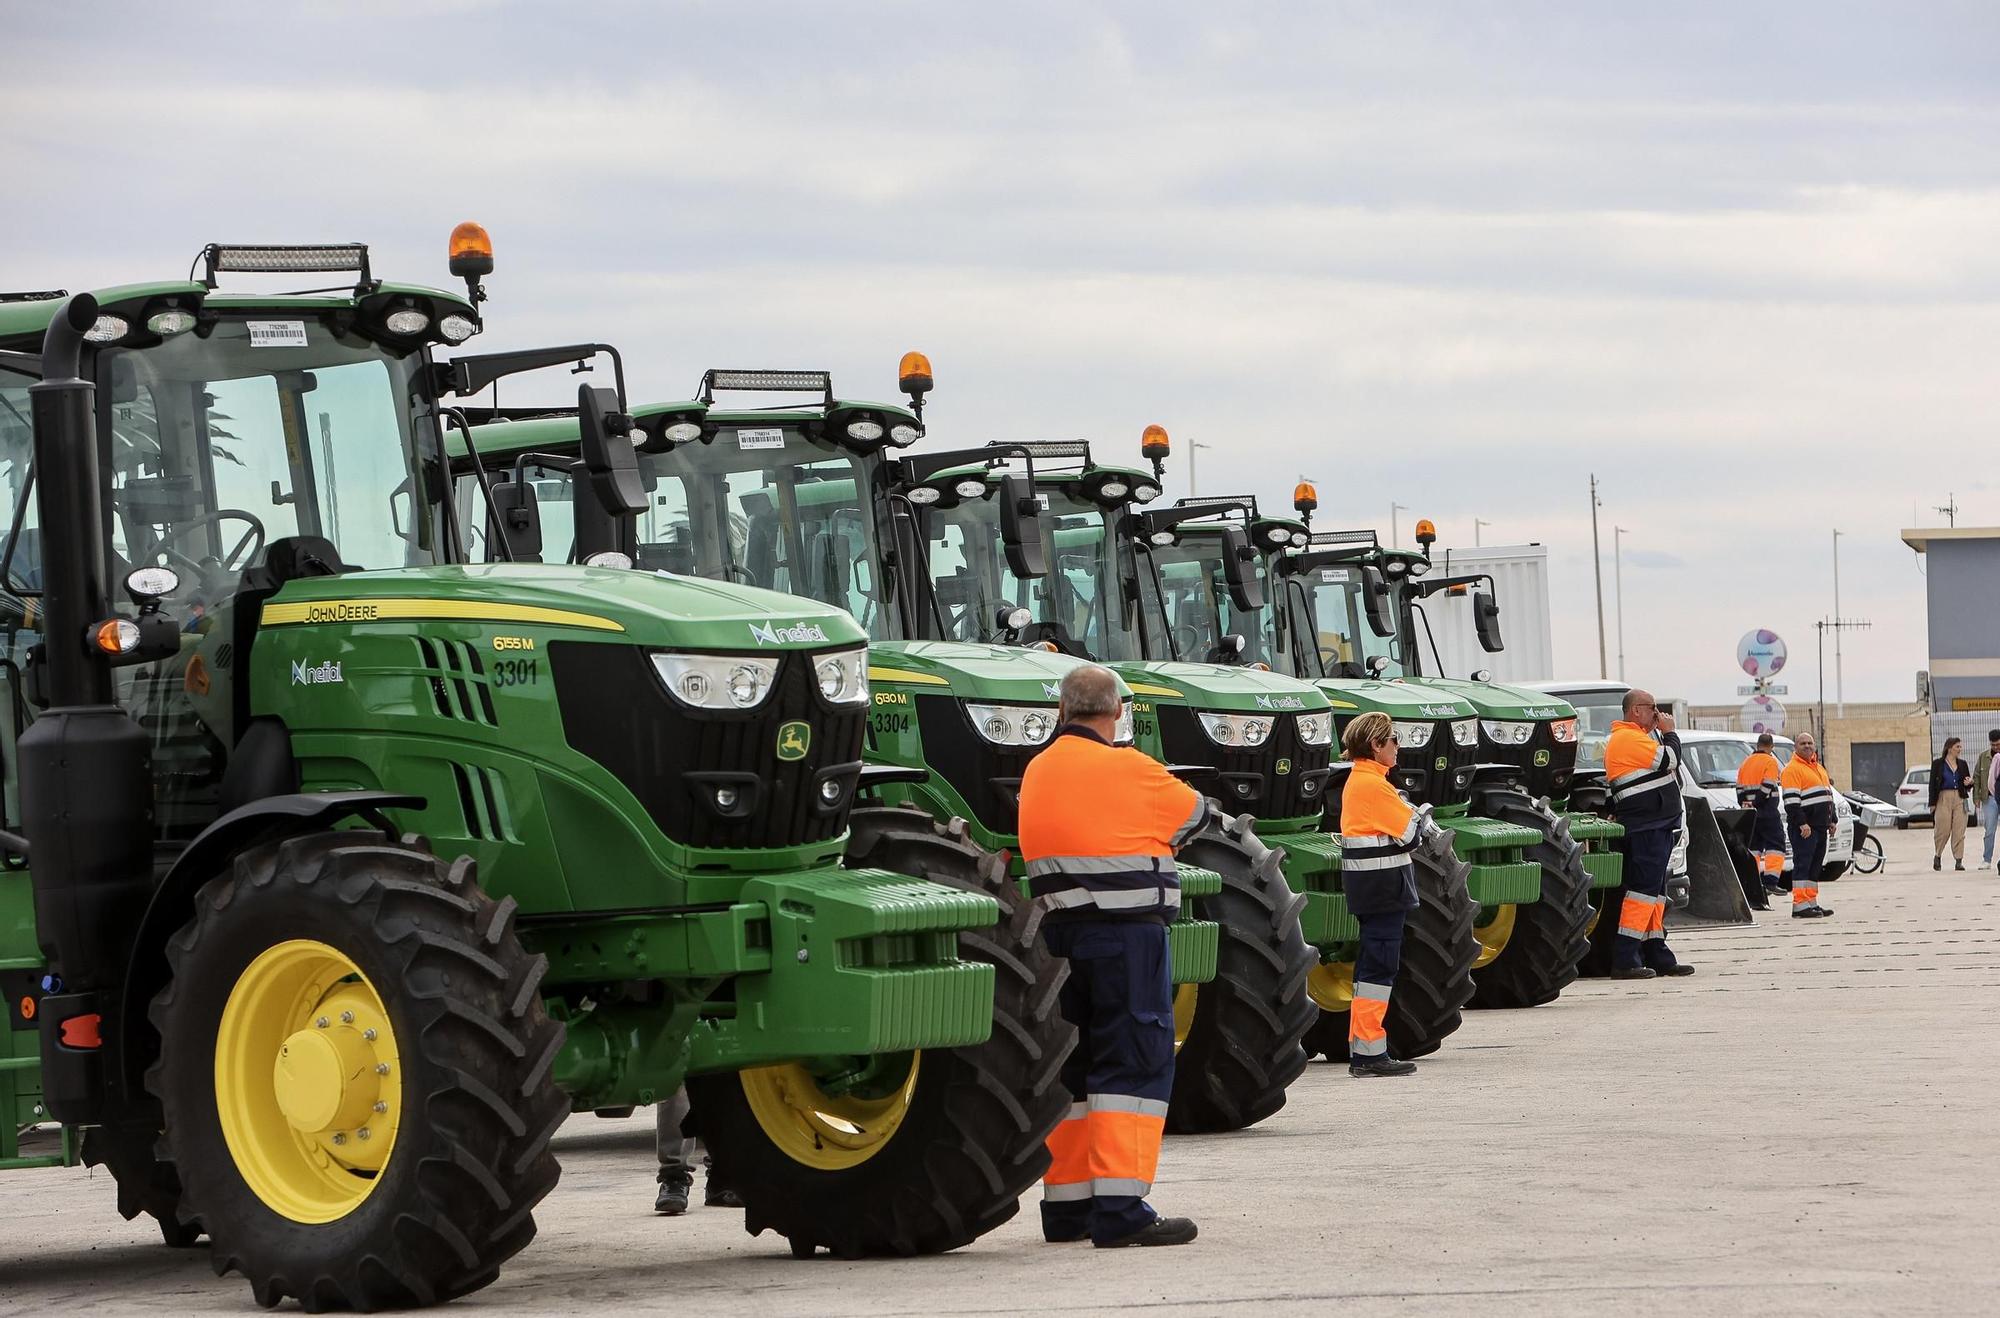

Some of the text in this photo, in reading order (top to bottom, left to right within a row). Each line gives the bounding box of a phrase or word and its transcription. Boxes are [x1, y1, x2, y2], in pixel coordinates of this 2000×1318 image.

[305, 604, 377, 621] JOHN DEERE
[494, 658, 536, 688] 3301
[875, 713, 909, 734] 3304
[1132, 719, 1152, 736] 305
